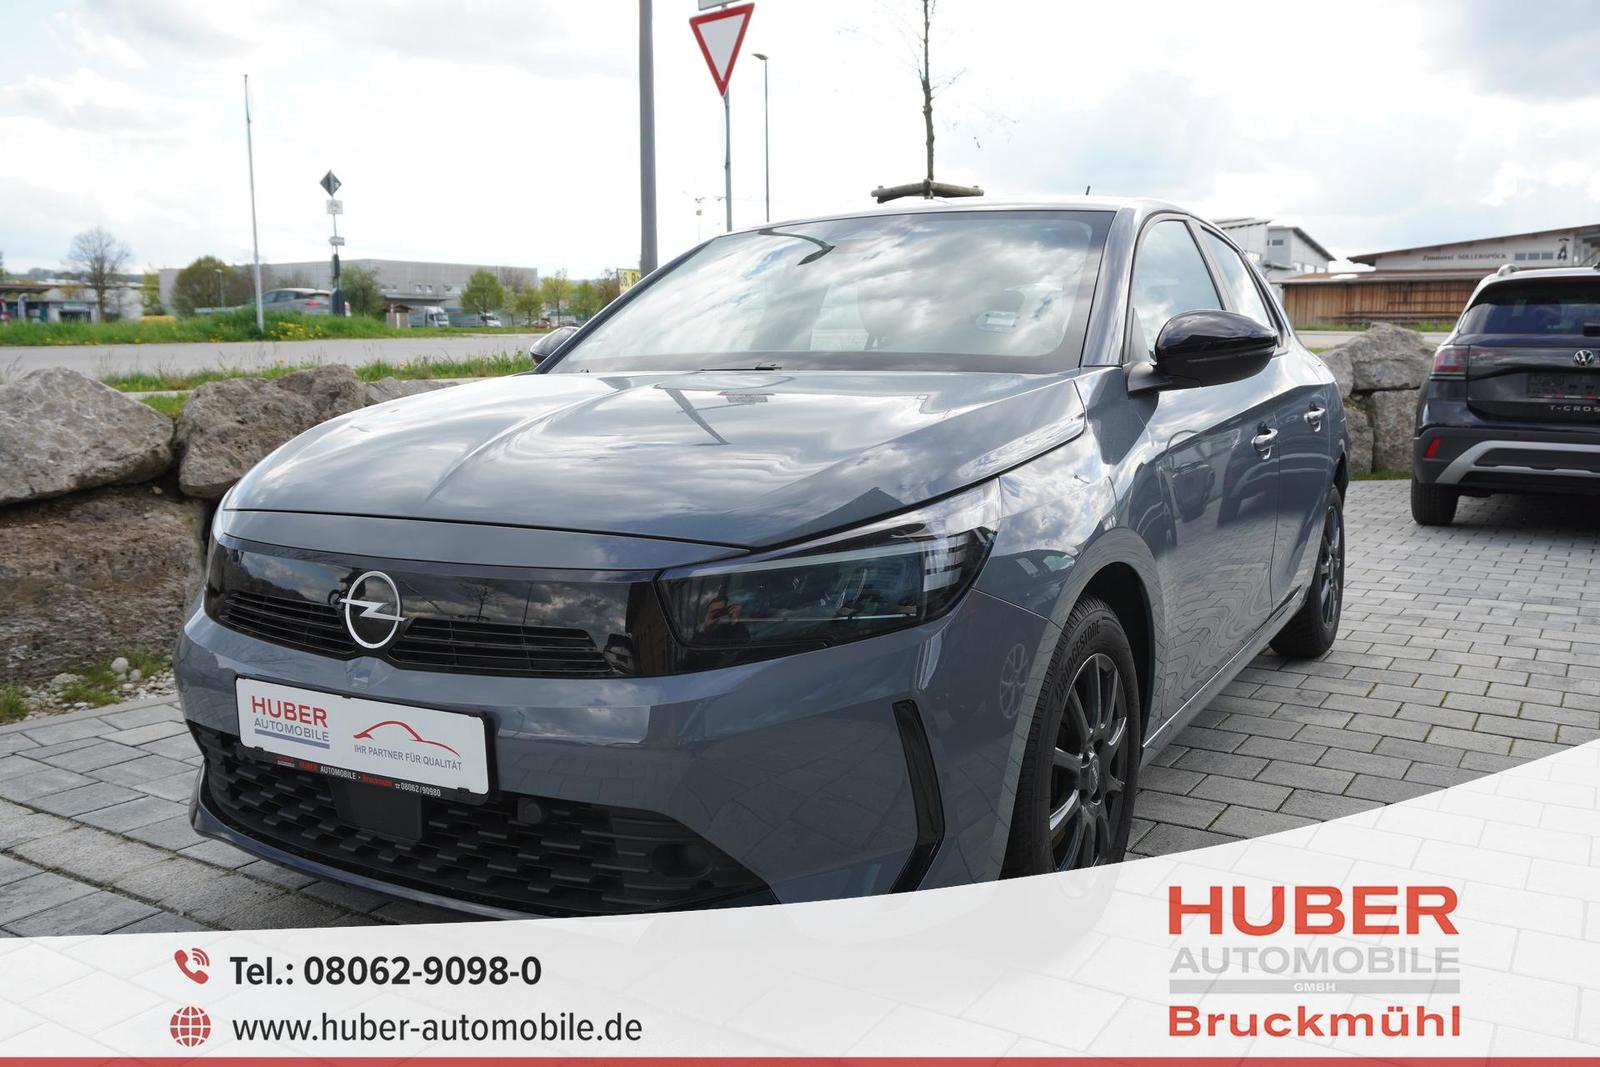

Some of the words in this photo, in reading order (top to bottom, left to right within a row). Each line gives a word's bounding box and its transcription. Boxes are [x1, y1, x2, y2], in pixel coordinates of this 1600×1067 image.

[251, 695, 328, 728] HUBER
[254, 717, 330, 742] AUTOMOBILE
[353, 743, 367, 755] IHR
[368, 746, 404, 761] PARTNER
[405, 750, 421, 763] FÜR
[422, 753, 462, 771] QUALITÄT
[320, 765, 357, 780] AUTOMOBILE
